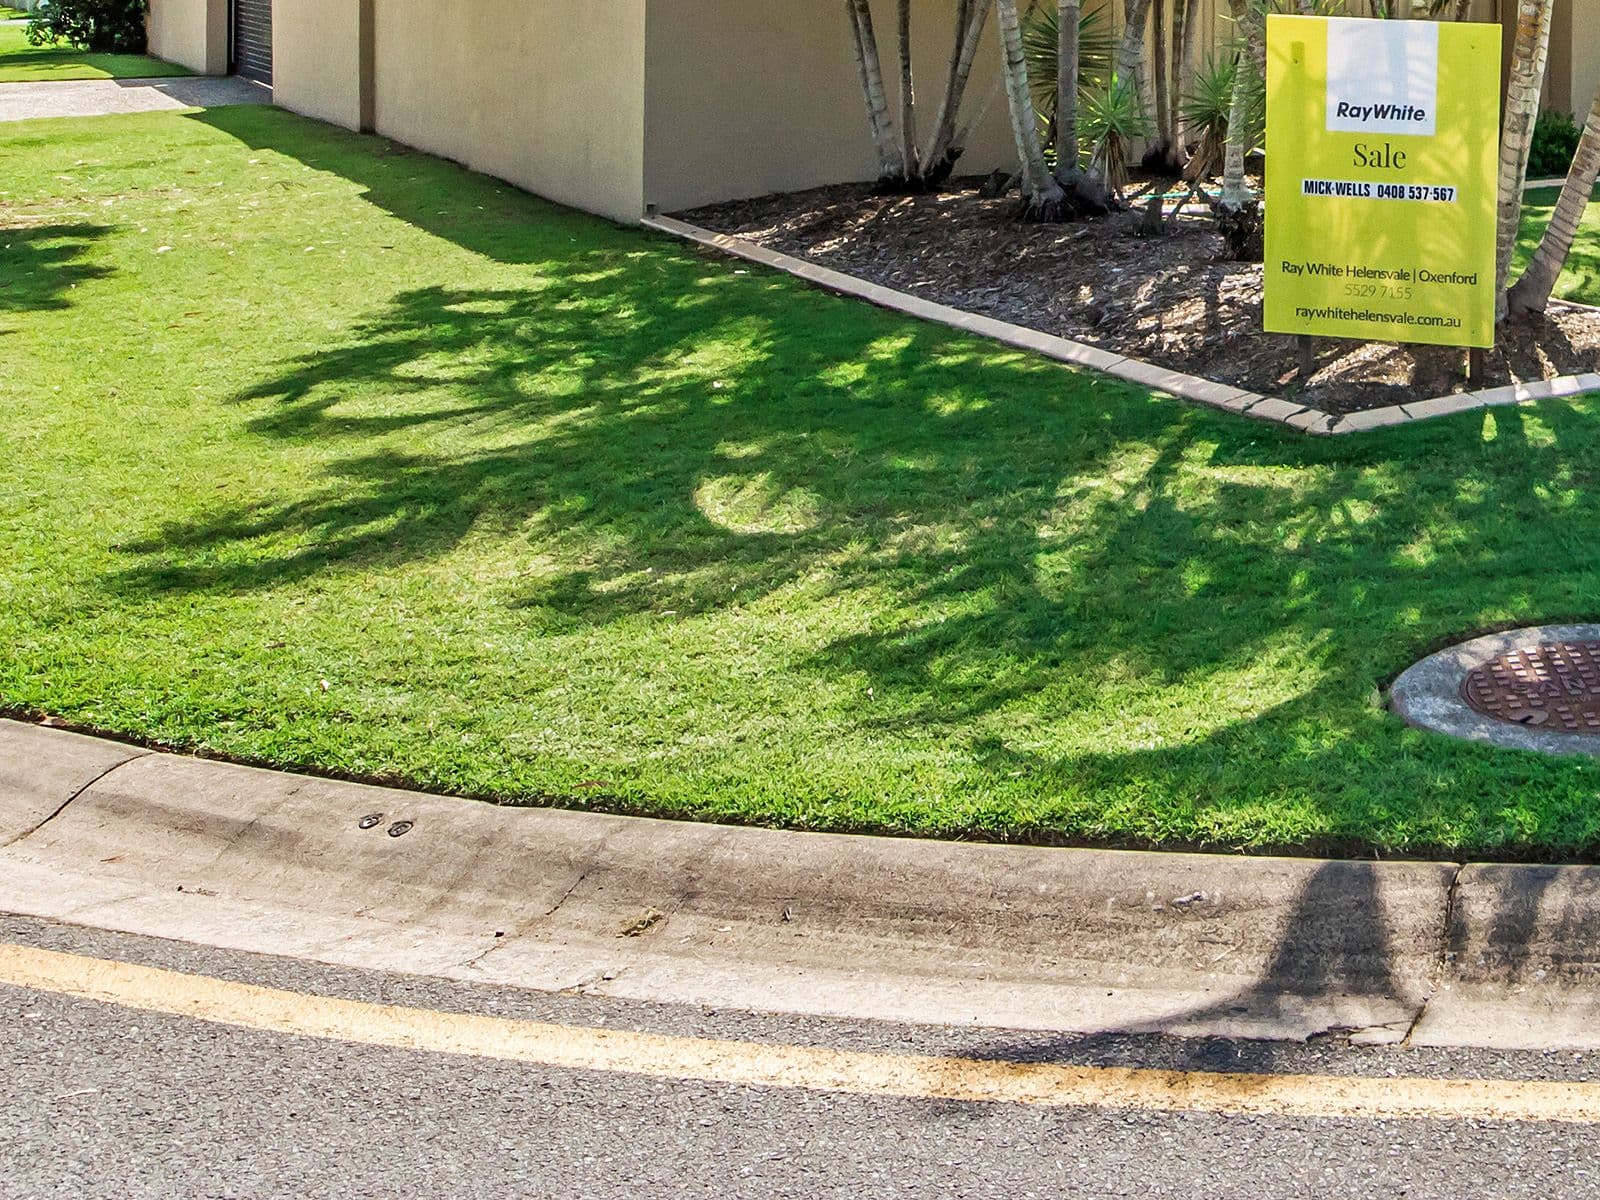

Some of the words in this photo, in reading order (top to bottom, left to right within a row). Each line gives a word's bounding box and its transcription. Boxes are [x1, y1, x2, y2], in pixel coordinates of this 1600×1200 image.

[1353, 143, 1406, 169] Sale
[1377, 184, 1405, 199] 0408
[1282, 261, 1304, 276] Ray
[1306, 262, 1343, 276] White
[1346, 265, 1410, 280] Helensvale
[1419, 269, 1477, 285] Oxenford
[1345, 283, 1376, 297] 5529
[1295, 307, 1461, 327] raywhitehelensvale.com.au
